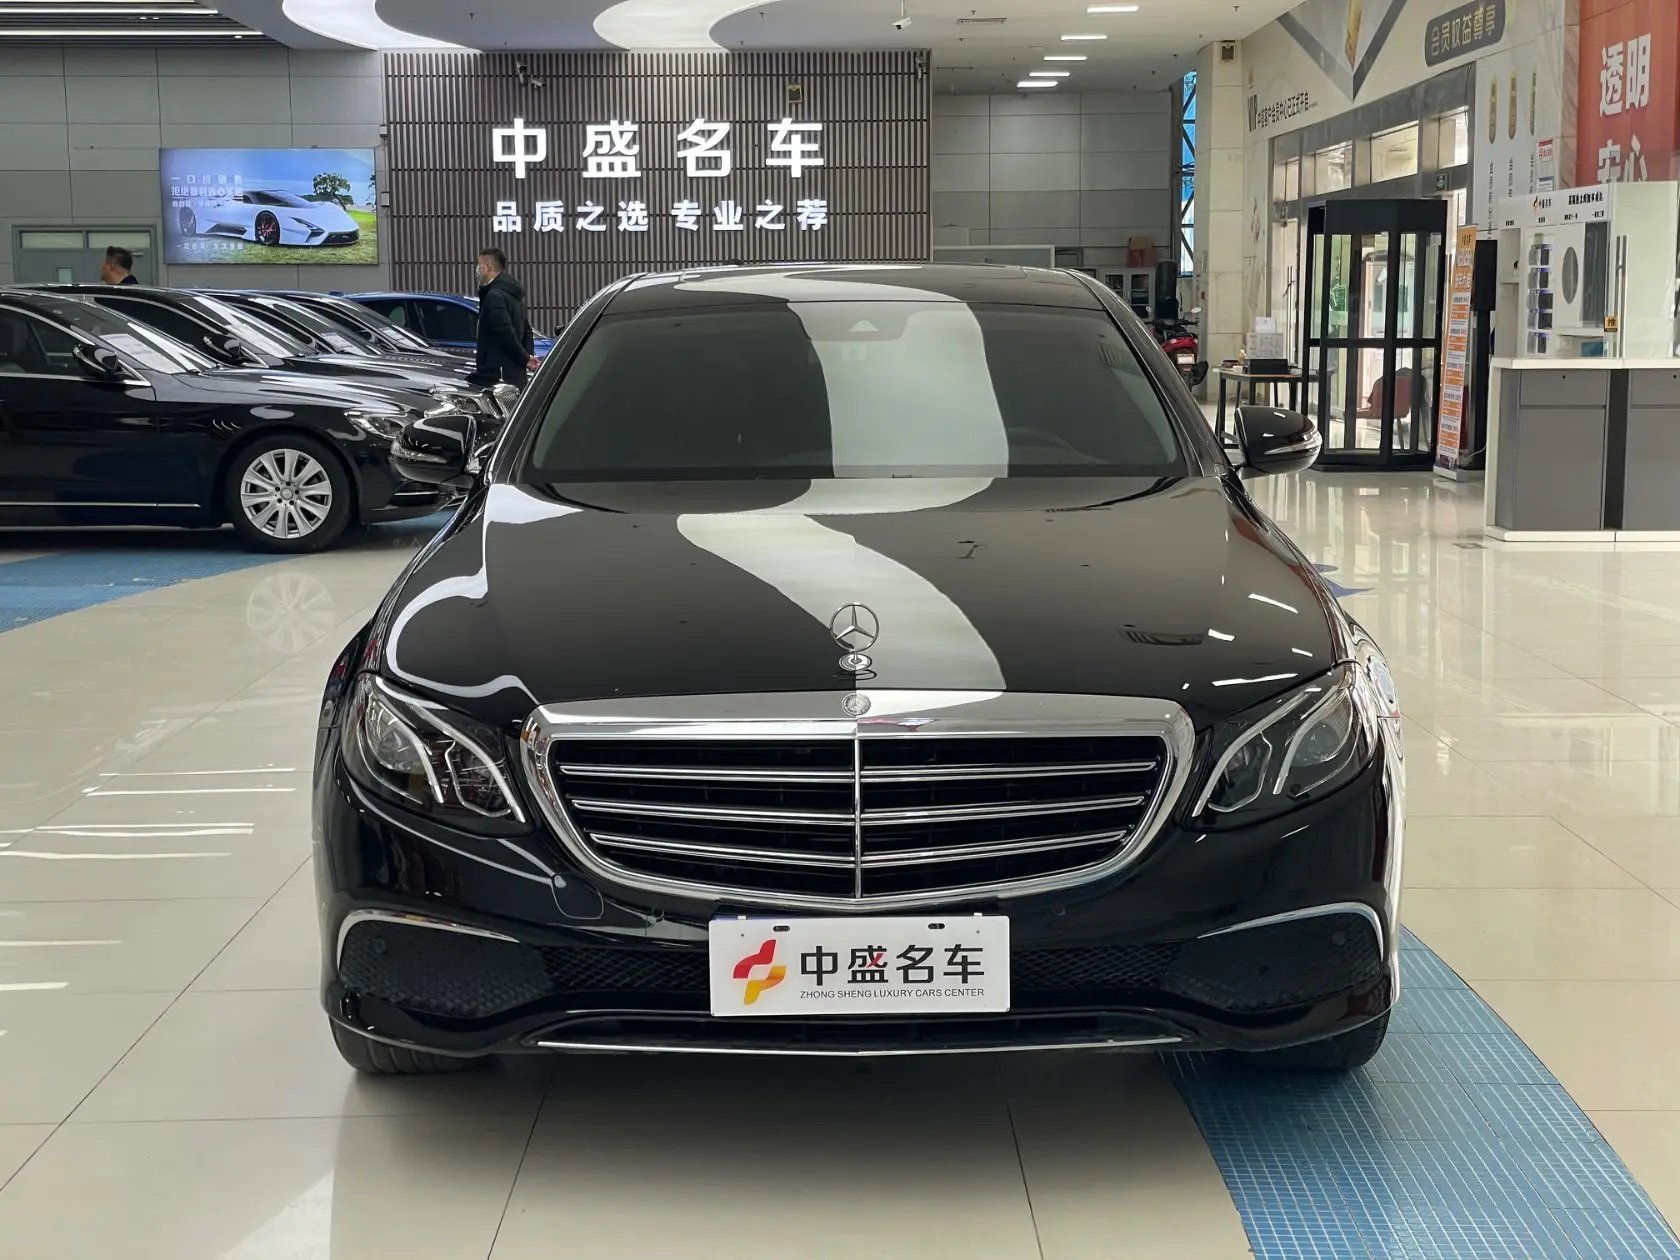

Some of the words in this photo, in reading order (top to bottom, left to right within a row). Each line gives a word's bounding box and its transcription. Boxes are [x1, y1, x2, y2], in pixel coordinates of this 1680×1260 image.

[1431, 4, 1496, 56] 会员权益尊享
[1599, 33, 1651, 117] 透明
[492, 117, 824, 179] 中盛名车
[1597, 134, 1648, 184] 安心
[493, 200, 648, 232] 品质之选
[671, 199, 828, 231] 专业之荐
[800, 943, 985, 986] 中盛名车
[800, 990, 835, 999] ZHONG
[837, 989, 872, 998] SHENG
[873, 989, 913, 998] LUXURY
[915, 988, 942, 997] CARS
[944, 988, 985, 997] CENTER
